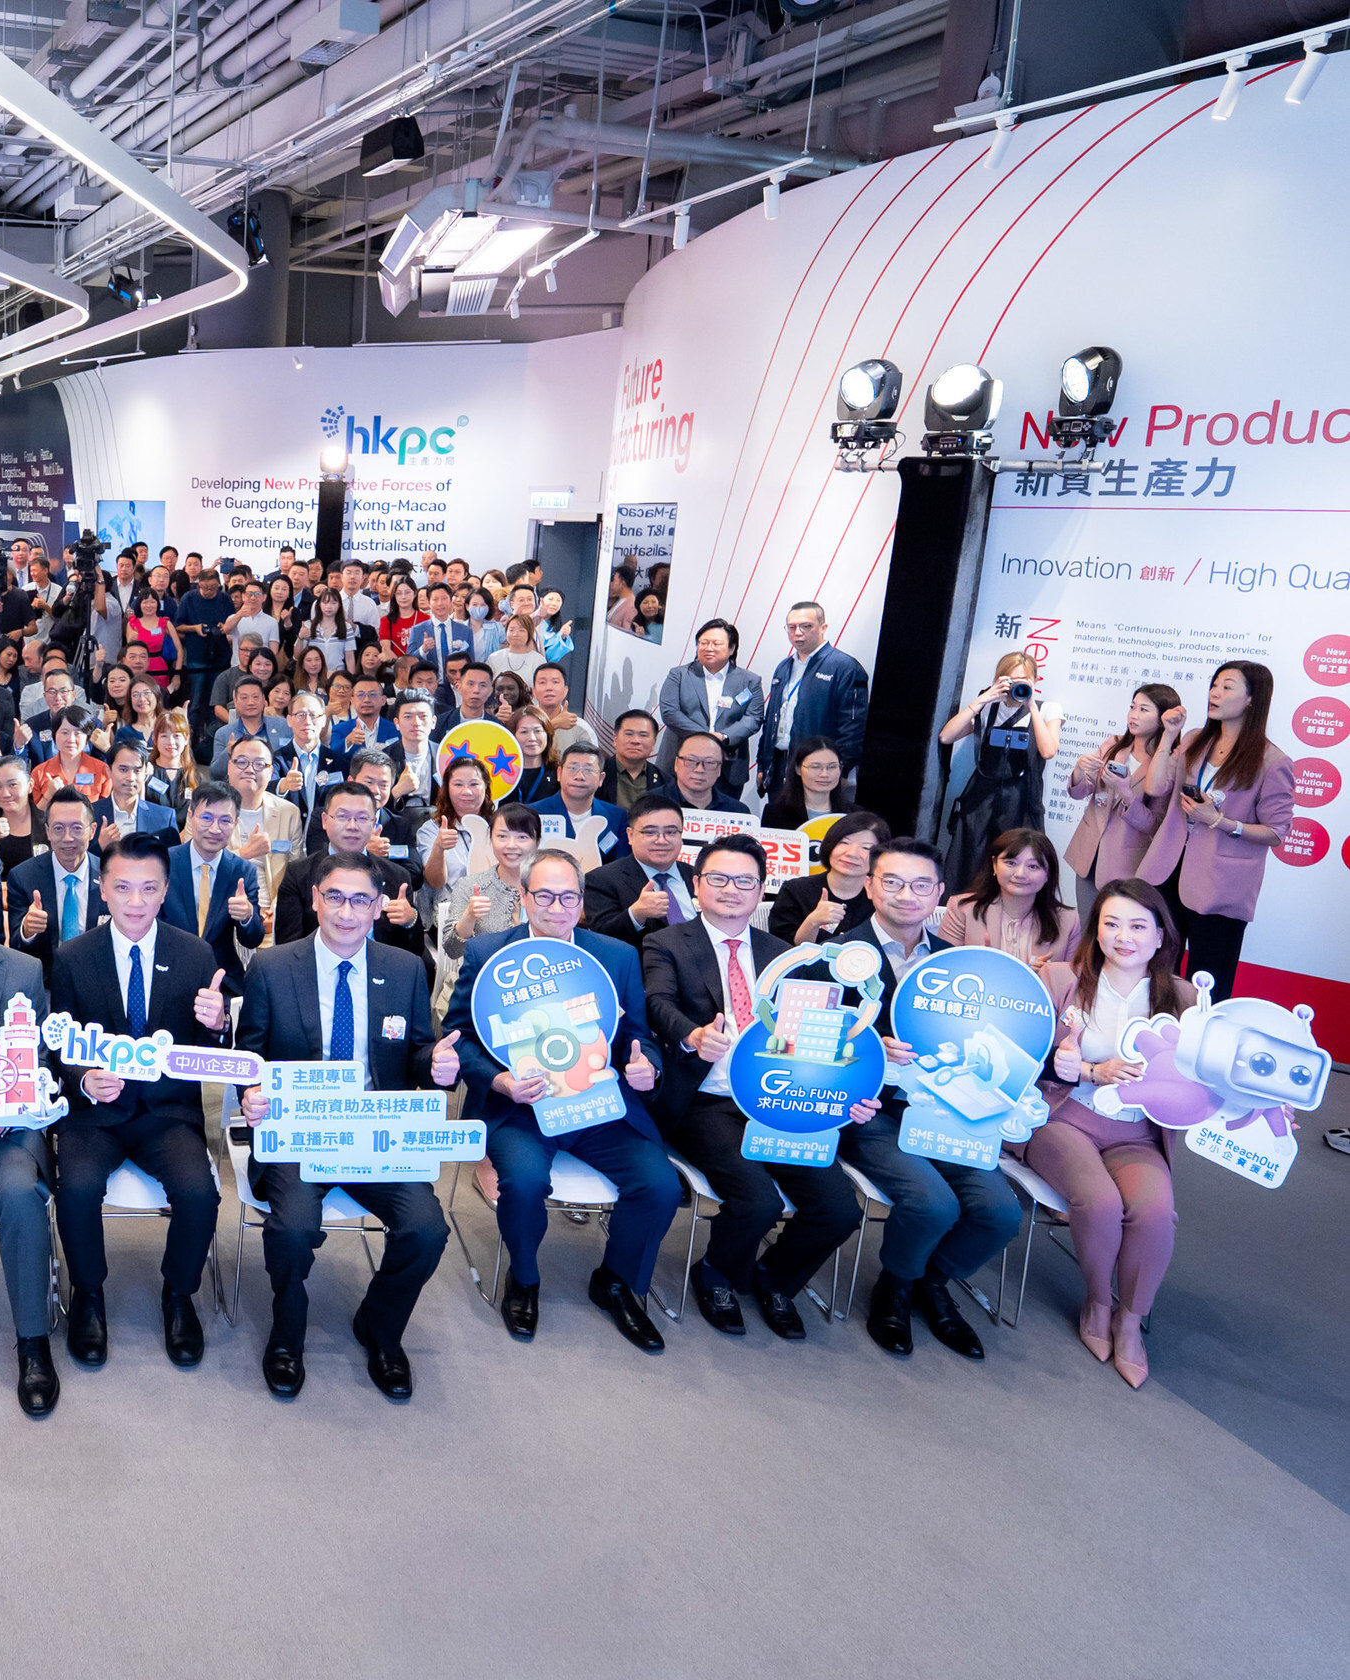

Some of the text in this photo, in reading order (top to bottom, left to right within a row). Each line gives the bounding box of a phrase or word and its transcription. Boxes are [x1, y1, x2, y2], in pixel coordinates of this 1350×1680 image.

[622, 357, 663, 411] Future
[346, 415, 457, 465] hkpc
[191, 477, 452, 493] Developing New Forces of
[201, 497, 447, 514] the Kong-Macao
[231, 517, 445, 532] Greater Bay with I&T and
[219, 535, 290, 549] Promoting
[1001, 553, 1132, 580] Innovation
[1139, 566, 1175, 582] 創新
[1209, 561, 1277, 593] High
[994, 613, 1022, 640] 新
[1076, 620, 1106, 630] Means
[1257, 634, 1273, 642] for
[1073, 645, 1203, 664] production methods, business
[1074, 632, 1269, 656] materials, technologies, products, services,
[1326, 648, 1347, 656] New
[1302, 717, 1344, 727] Products
[1314, 709, 1334, 718] New
[1306, 726, 1335, 736] 新產品
[1302, 770, 1323, 779] New
[1295, 786, 1324, 796] 新技術
[1284, 836, 1315, 847] Modes
[1291, 829, 1311, 838] New
[1284, 845, 1312, 856] 新模式
[540, 957, 583, 979] GREEN
[501, 979, 559, 1007] 綠續發展
[912, 995, 980, 1020] 數碼轉型
[967, 992, 983, 1003] AI
[986, 994, 996, 1006] &
[1000, 996, 1051, 1017] DIGITAL
[67, 1027, 158, 1072] hkpc
[176, 1055, 251, 1076] 中小企支援
[271, 1068, 357, 1091] 5 主題專區
[760, 1069, 848, 1101] Grab FUND
[295, 1098, 441, 1113] 政府資助及科技展位
[543, 1094, 616, 1121] SME ReachOut
[757, 1096, 845, 1117] 求FUND專區
[261, 1130, 483, 1153] 10+ 直播示範 10+ 專題研討會
[751, 1136, 830, 1153] SME ReachOut
[909, 1128, 994, 1154] SME ReachOut
[1200, 1127, 1280, 1172] SME ReachOut
[313, 1164, 337, 1175] hkpc
